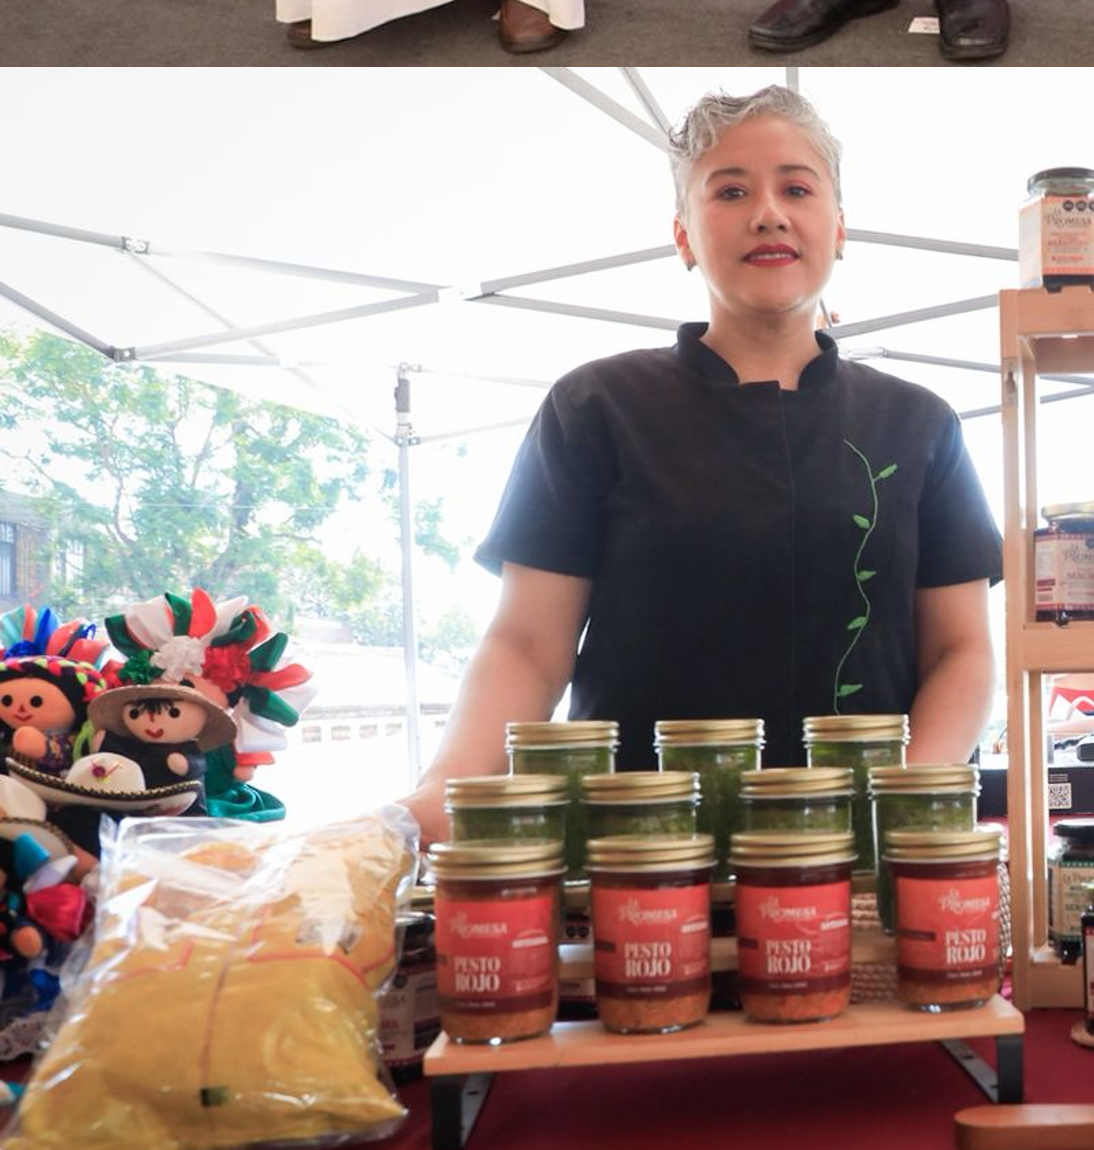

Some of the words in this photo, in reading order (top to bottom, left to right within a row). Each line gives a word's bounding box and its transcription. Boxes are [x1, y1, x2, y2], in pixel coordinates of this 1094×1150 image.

[945, 928, 987, 946] PESTO
[624, 941, 672, 959] PESTO
[765, 938, 812, 956] PESTO
[946, 945, 987, 964] ROJO
[454, 956, 502, 973] PESTO
[625, 958, 672, 978] ROJO
[766, 955, 812, 974] ROJO
[455, 972, 501, 992] ROJO
